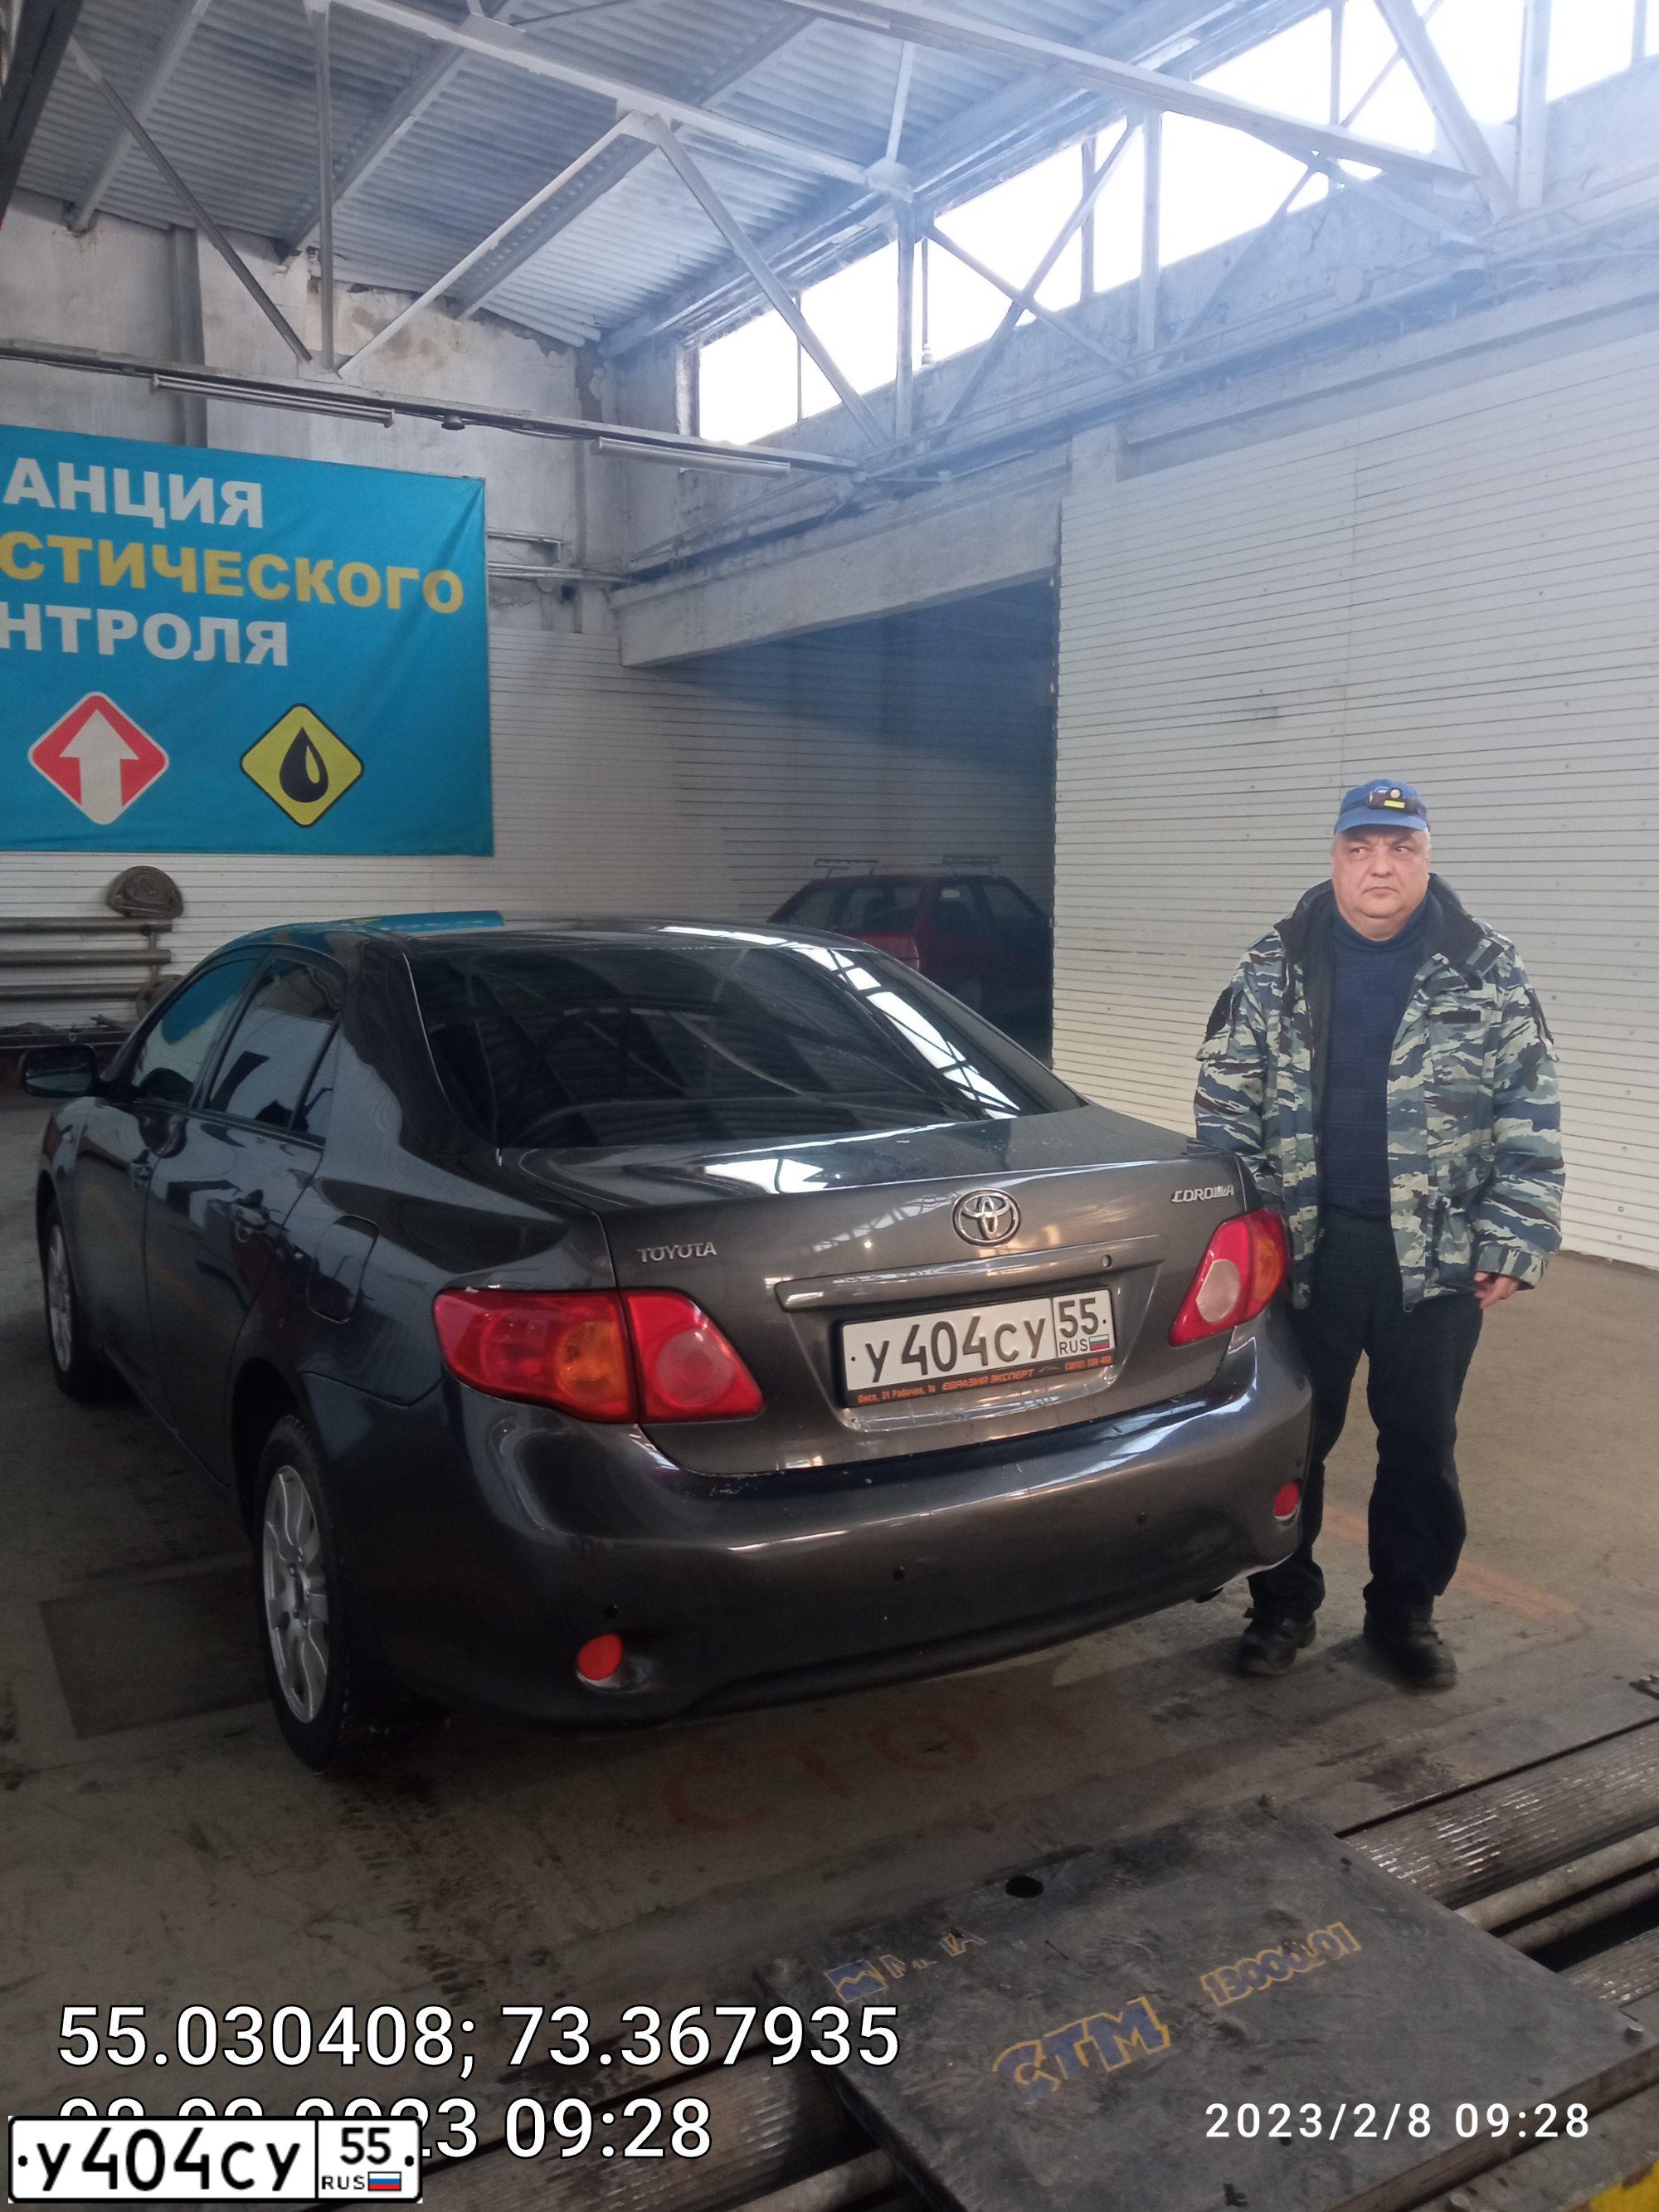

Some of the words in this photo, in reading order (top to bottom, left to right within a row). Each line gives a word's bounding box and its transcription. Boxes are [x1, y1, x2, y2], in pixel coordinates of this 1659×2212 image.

[3, 456, 265, 529] АНЦИЯ
[0, 530, 465, 614] СТИЧЕСКОГО
[0, 601, 289, 667] НТРОЛЯ
[1170, 1184, 1234, 1203] COROLLA
[636, 1241, 718, 1263] TOYOTA
[1057, 1297, 1100, 1339] 55
[1058, 1338, 1088, 1356] RUS
[990, 1368, 1035, 1384] ЭКСПЕРТ
